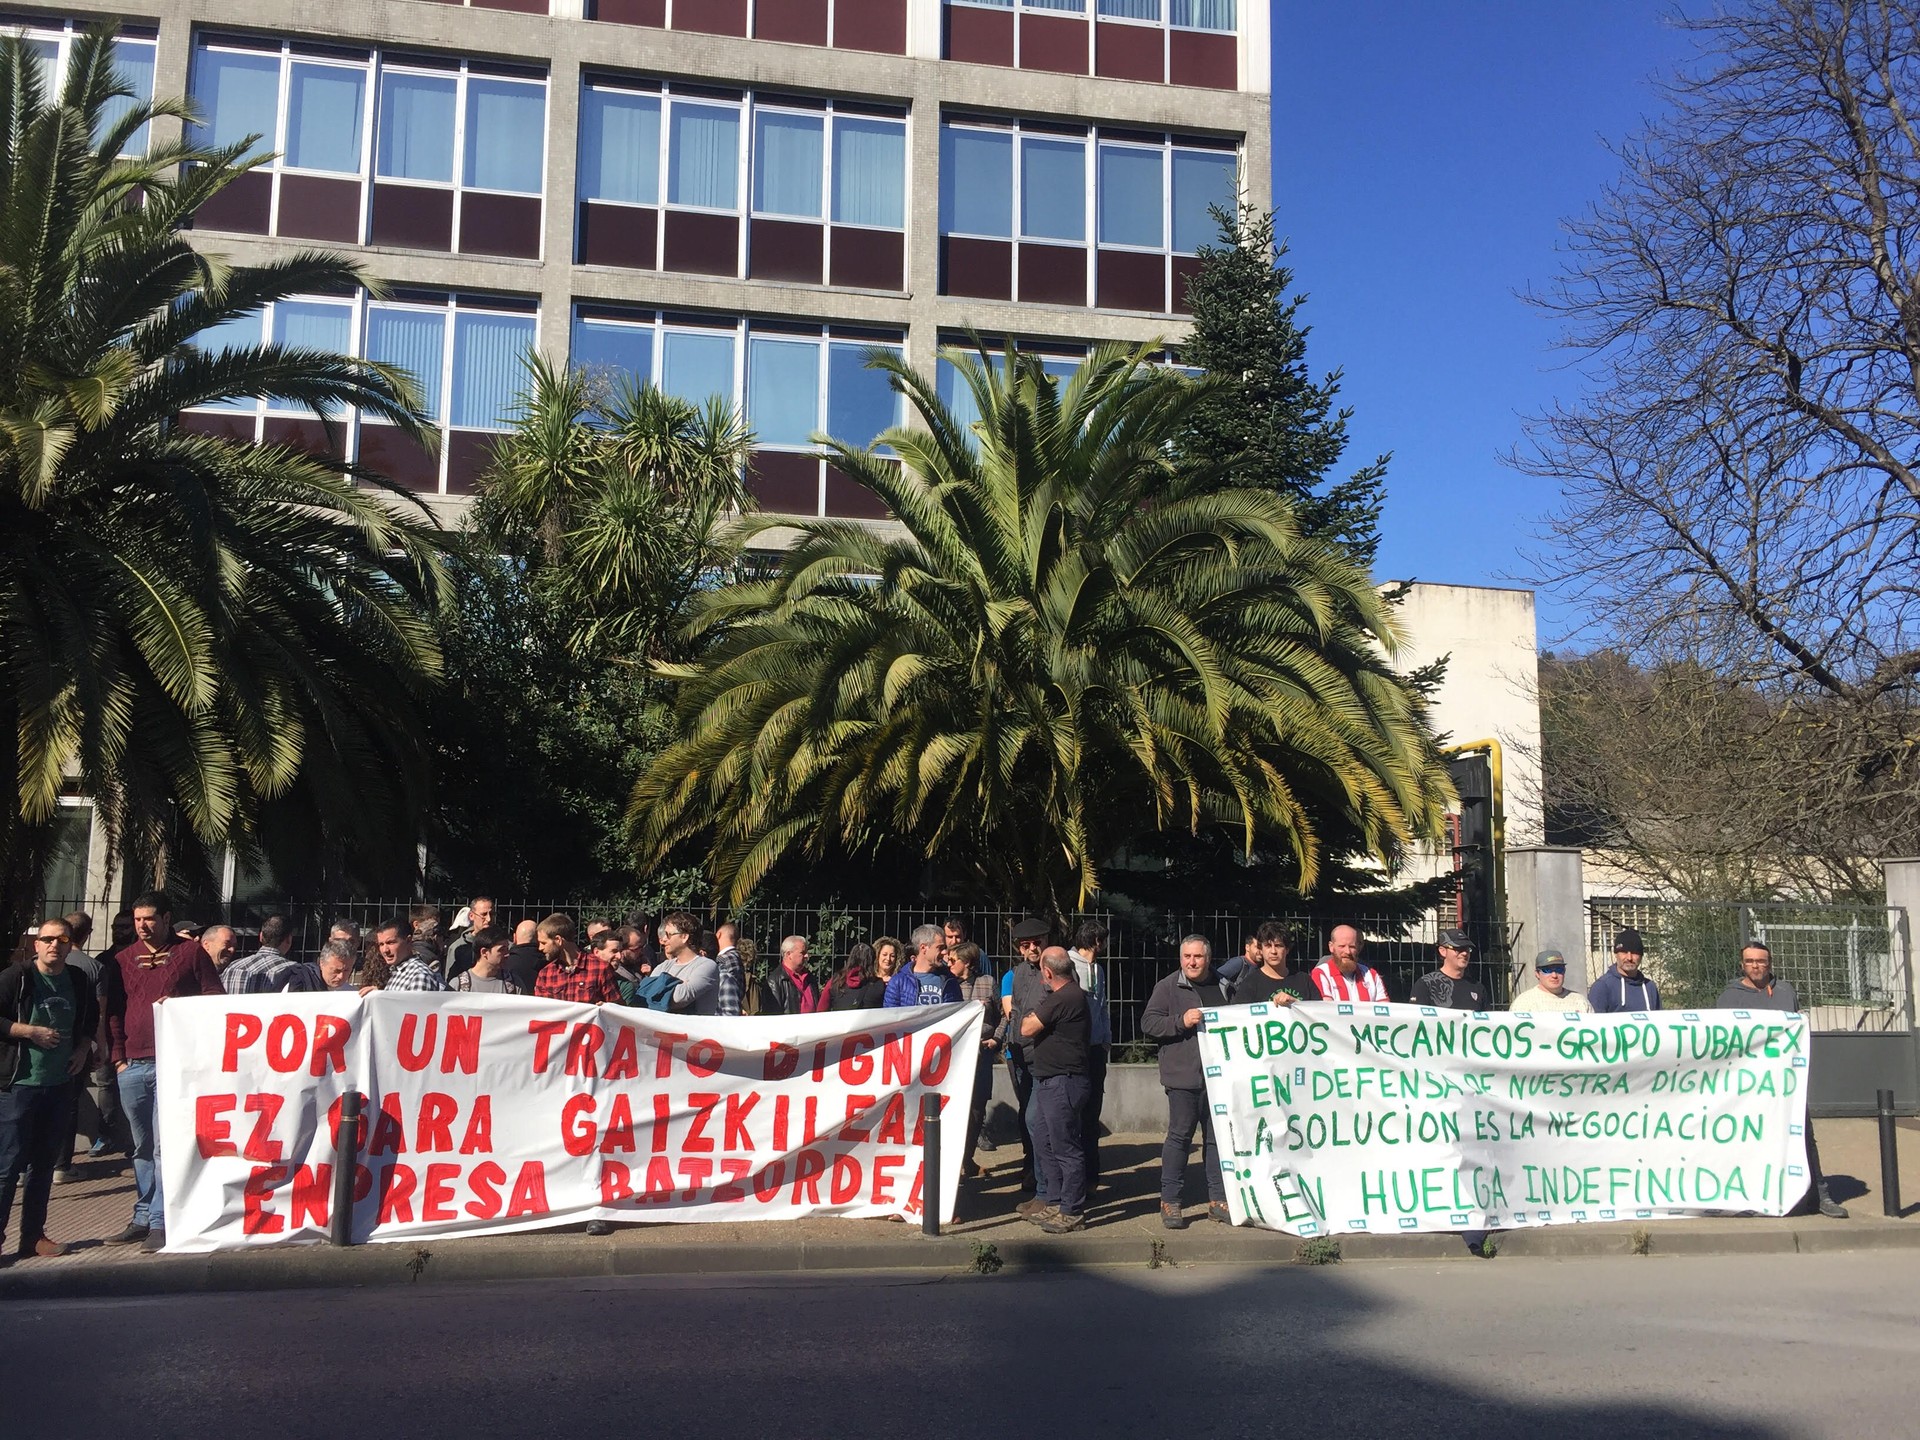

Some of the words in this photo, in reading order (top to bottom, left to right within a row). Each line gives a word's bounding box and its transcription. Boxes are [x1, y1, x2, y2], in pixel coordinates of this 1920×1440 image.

[222, 1013, 351, 1077] POR
[397, 1013, 483, 1075] UN
[528, 1019, 725, 1081] TRATO
[763, 1032, 952, 1086] DIGNO
[1208, 1020, 1329, 1061] TUBOS
[1668, 1023, 1804, 1060] TUBACEX
[1251, 1073, 1292, 1108] EN
[1509, 1072, 1629, 1100] NUESTRA
[195, 1092, 285, 1163] EZ
[1475, 1110, 1500, 1142] ES
[1510, 1110, 1535, 1140] LA
[1361, 1166, 1509, 1215] HUELGA
